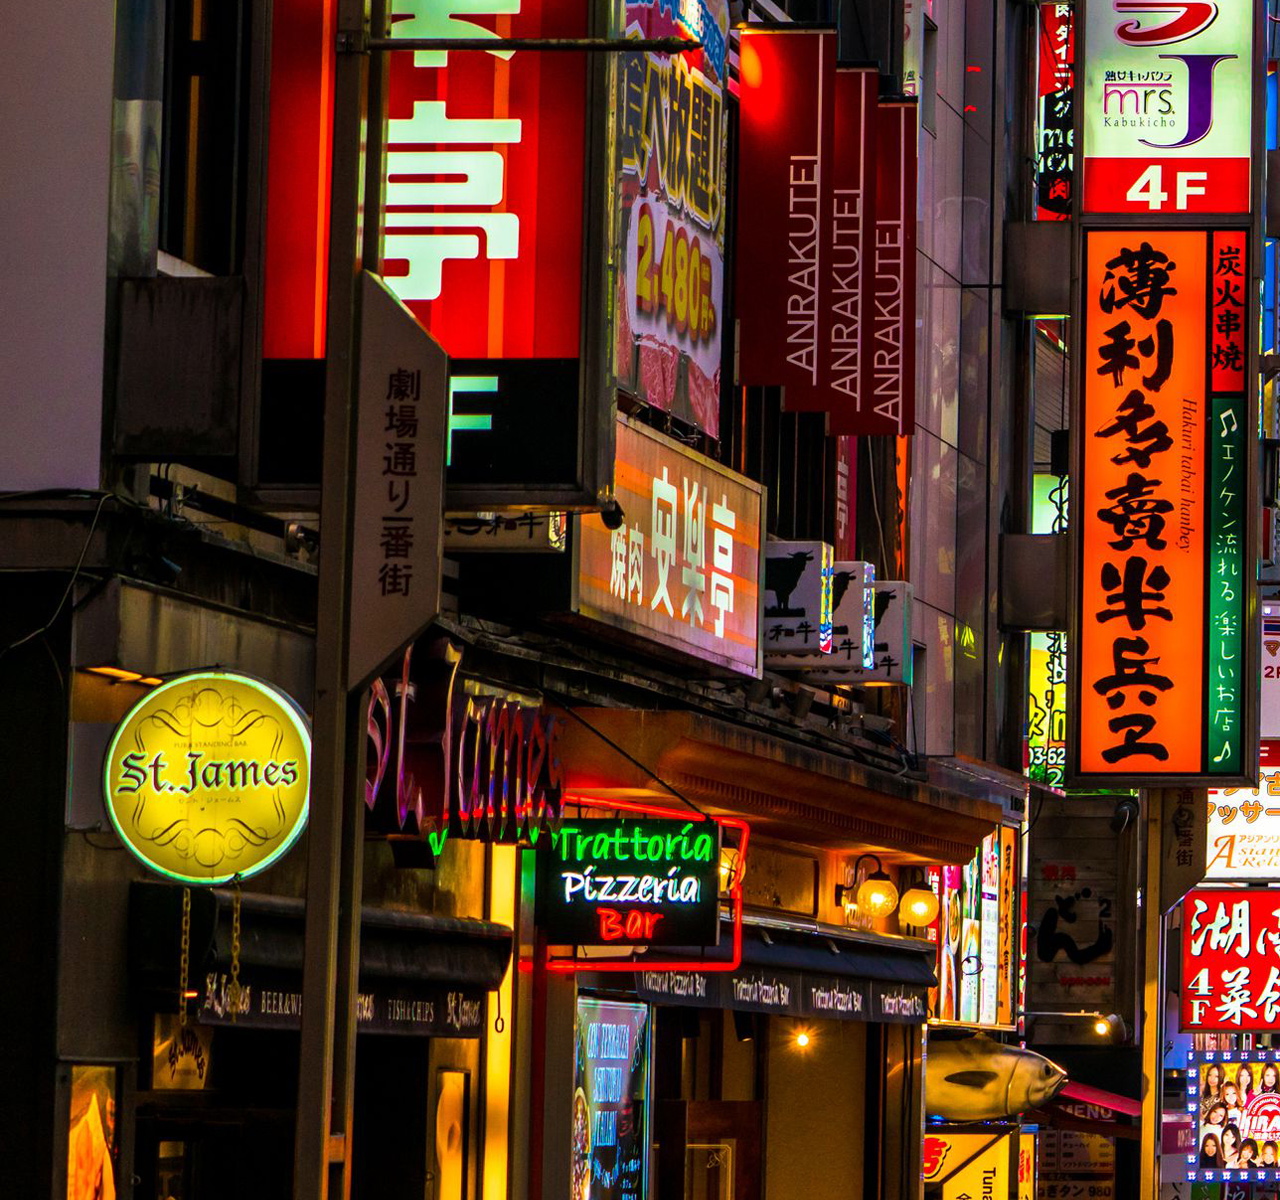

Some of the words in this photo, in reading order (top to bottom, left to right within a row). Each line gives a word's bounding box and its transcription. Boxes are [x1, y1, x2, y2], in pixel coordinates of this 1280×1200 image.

[1104, 69, 1174, 83] 熟女キャバクラ
[1103, 116, 1177, 129] Kabukicho
[1126, 165, 1207, 211] 4F
[786, 154, 820, 372] ANRAKUTEI
[830, 189, 862, 399] ANRAKUTEI
[873, 219, 903, 422] ANRAKUTEI
[1212, 244, 1245, 371] 炭火串焼
[378, 367, 422, 598] 劇場通り一番街
[609, 522, 644, 607] 焼肉
[558, 823, 713, 862] Trattoria
[561, 865, 701, 903] Pizzeria
[596, 907, 664, 941] Bar
